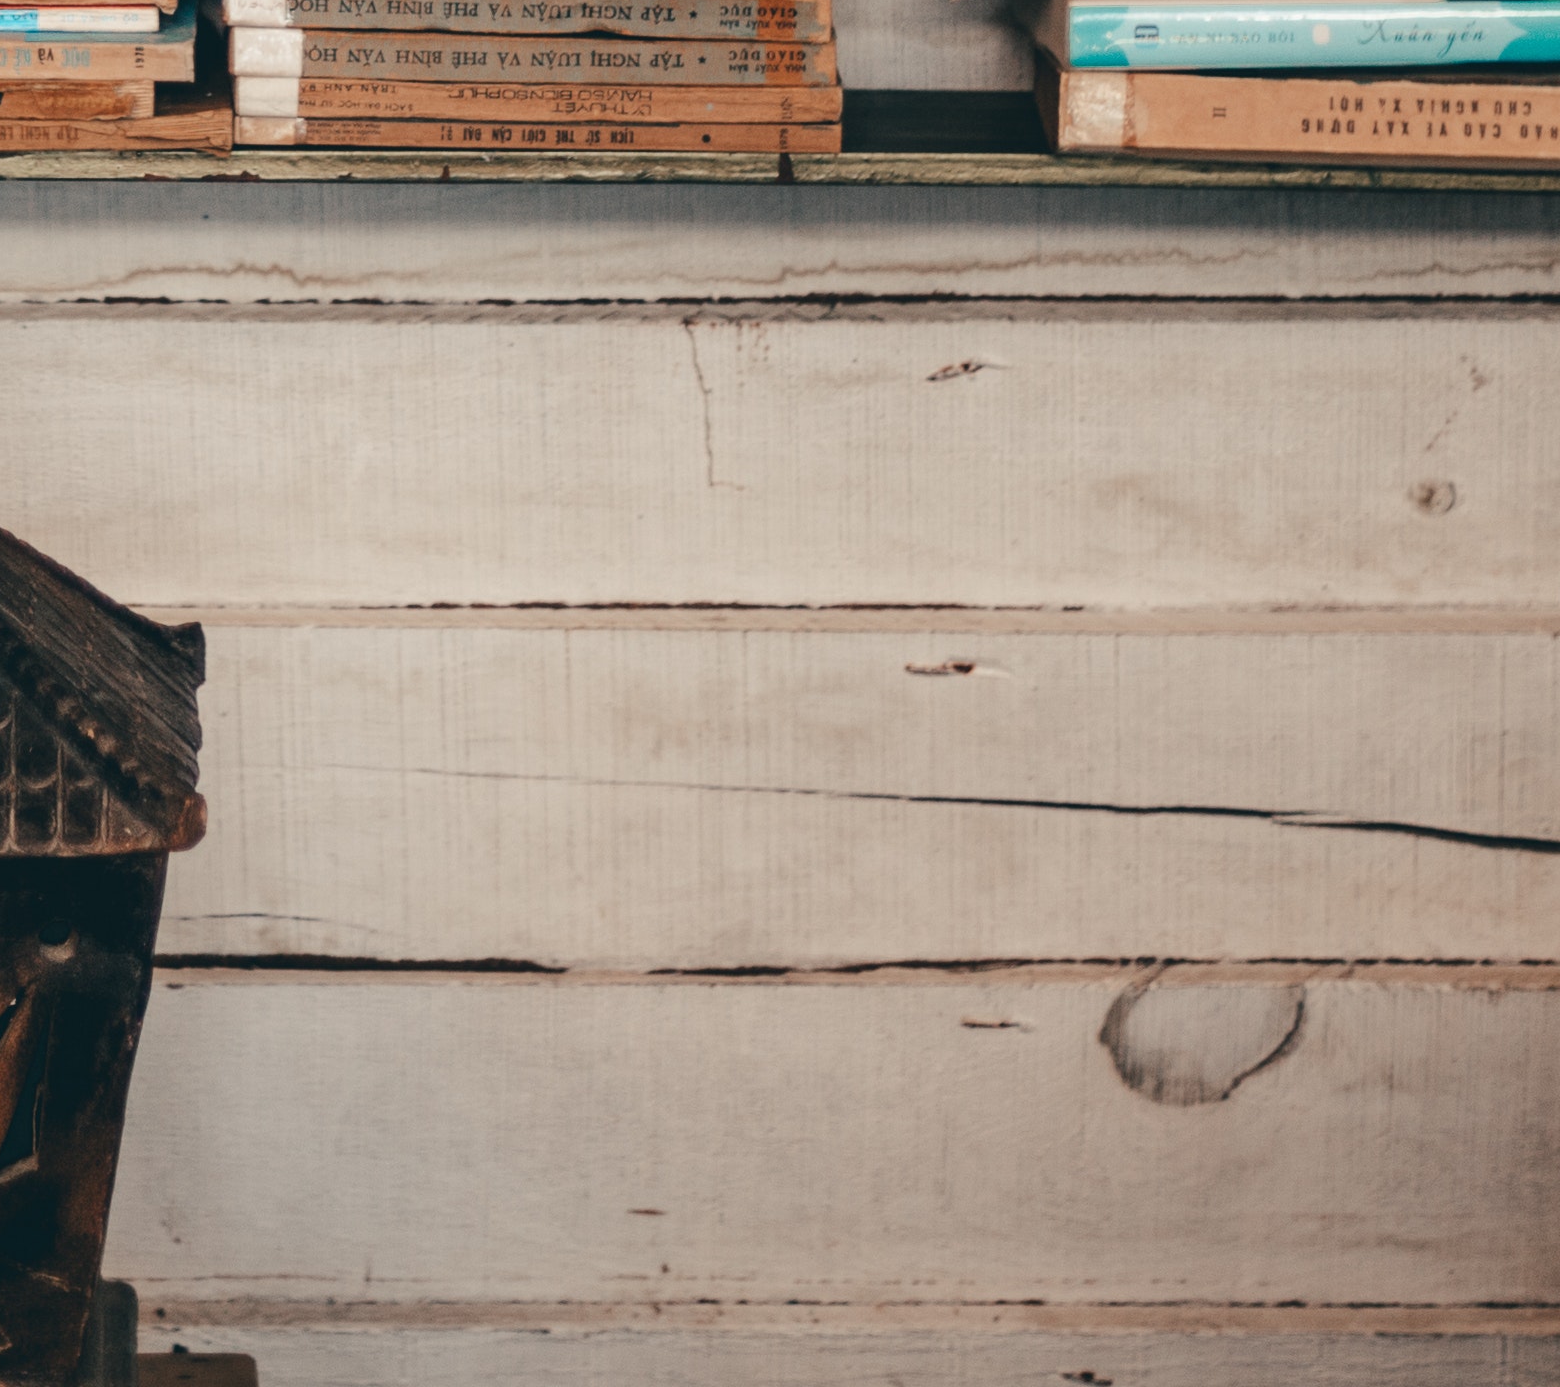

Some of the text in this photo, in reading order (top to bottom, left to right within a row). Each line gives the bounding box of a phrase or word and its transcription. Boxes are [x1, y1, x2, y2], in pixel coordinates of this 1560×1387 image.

[441, 0, 478, 22] PHÊ
[487, 2, 512, 23] VÀ
[520, 0, 571, 21] LUẬN
[639, 3, 675, 23] TẬP
